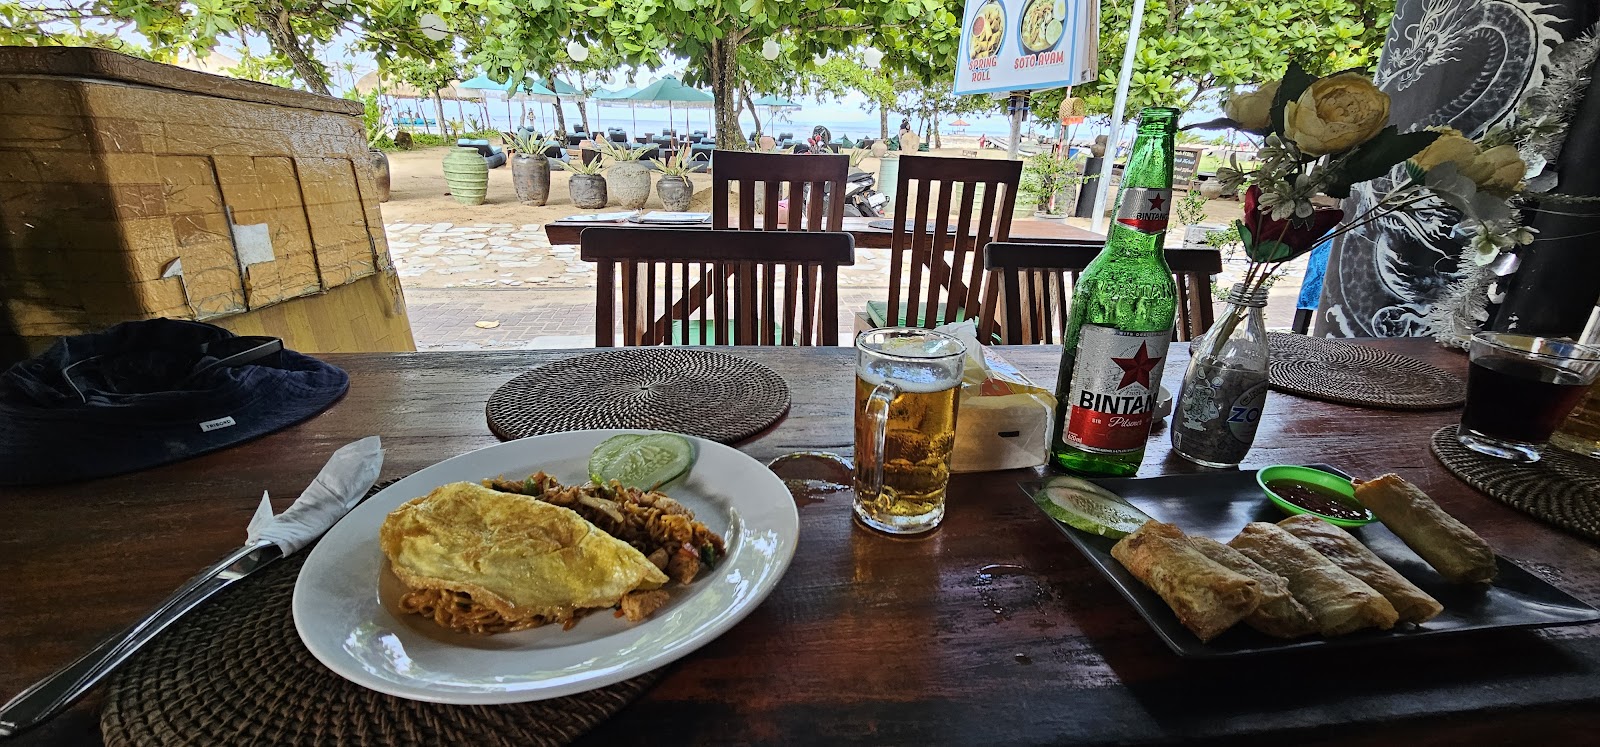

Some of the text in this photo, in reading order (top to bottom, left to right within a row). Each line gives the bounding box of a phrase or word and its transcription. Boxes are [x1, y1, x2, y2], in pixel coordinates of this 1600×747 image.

[969, 56, 997, 71] SPRING
[1014, 51, 1064, 70] SOTO AYAM
[971, 71, 990, 82] ROLL
[1136, 212, 1169, 221] BINTANG
